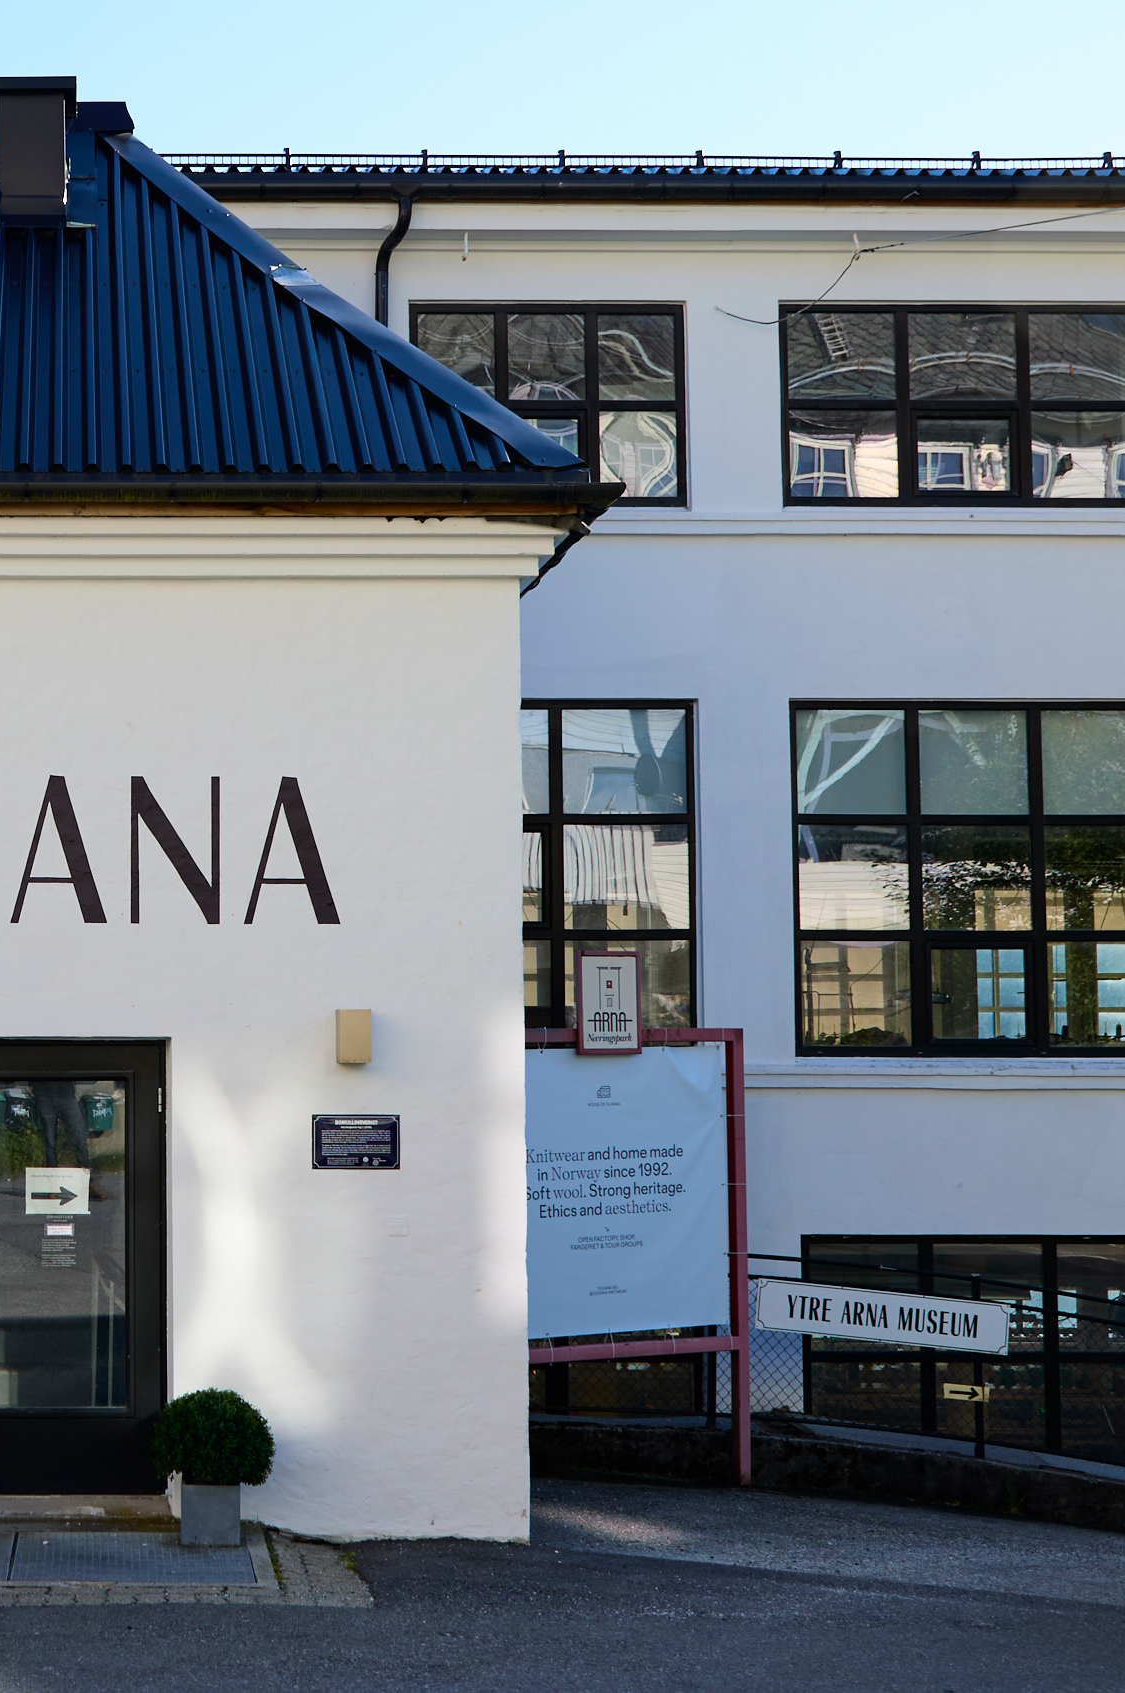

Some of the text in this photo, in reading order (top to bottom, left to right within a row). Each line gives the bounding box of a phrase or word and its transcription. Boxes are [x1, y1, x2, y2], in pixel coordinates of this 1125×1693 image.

[592, 1011, 628, 1032] ARNA
[587, 1033, 632, 1045] Næringspark
[526, 1143, 683, 1163] Knitwear and home made
[537, 1162, 672, 1183] in Norway since 1992.
[526, 1181, 686, 1200] Soft wool. Strong heritage.
[539, 1199, 672, 1218] Ethics and aesthetics.
[570, 1243, 599, 1251] FARGERIET
[621, 1240, 643, 1248] GROUPS
[787, 1294, 979, 1339] YTRE ARNA MUSEUM
